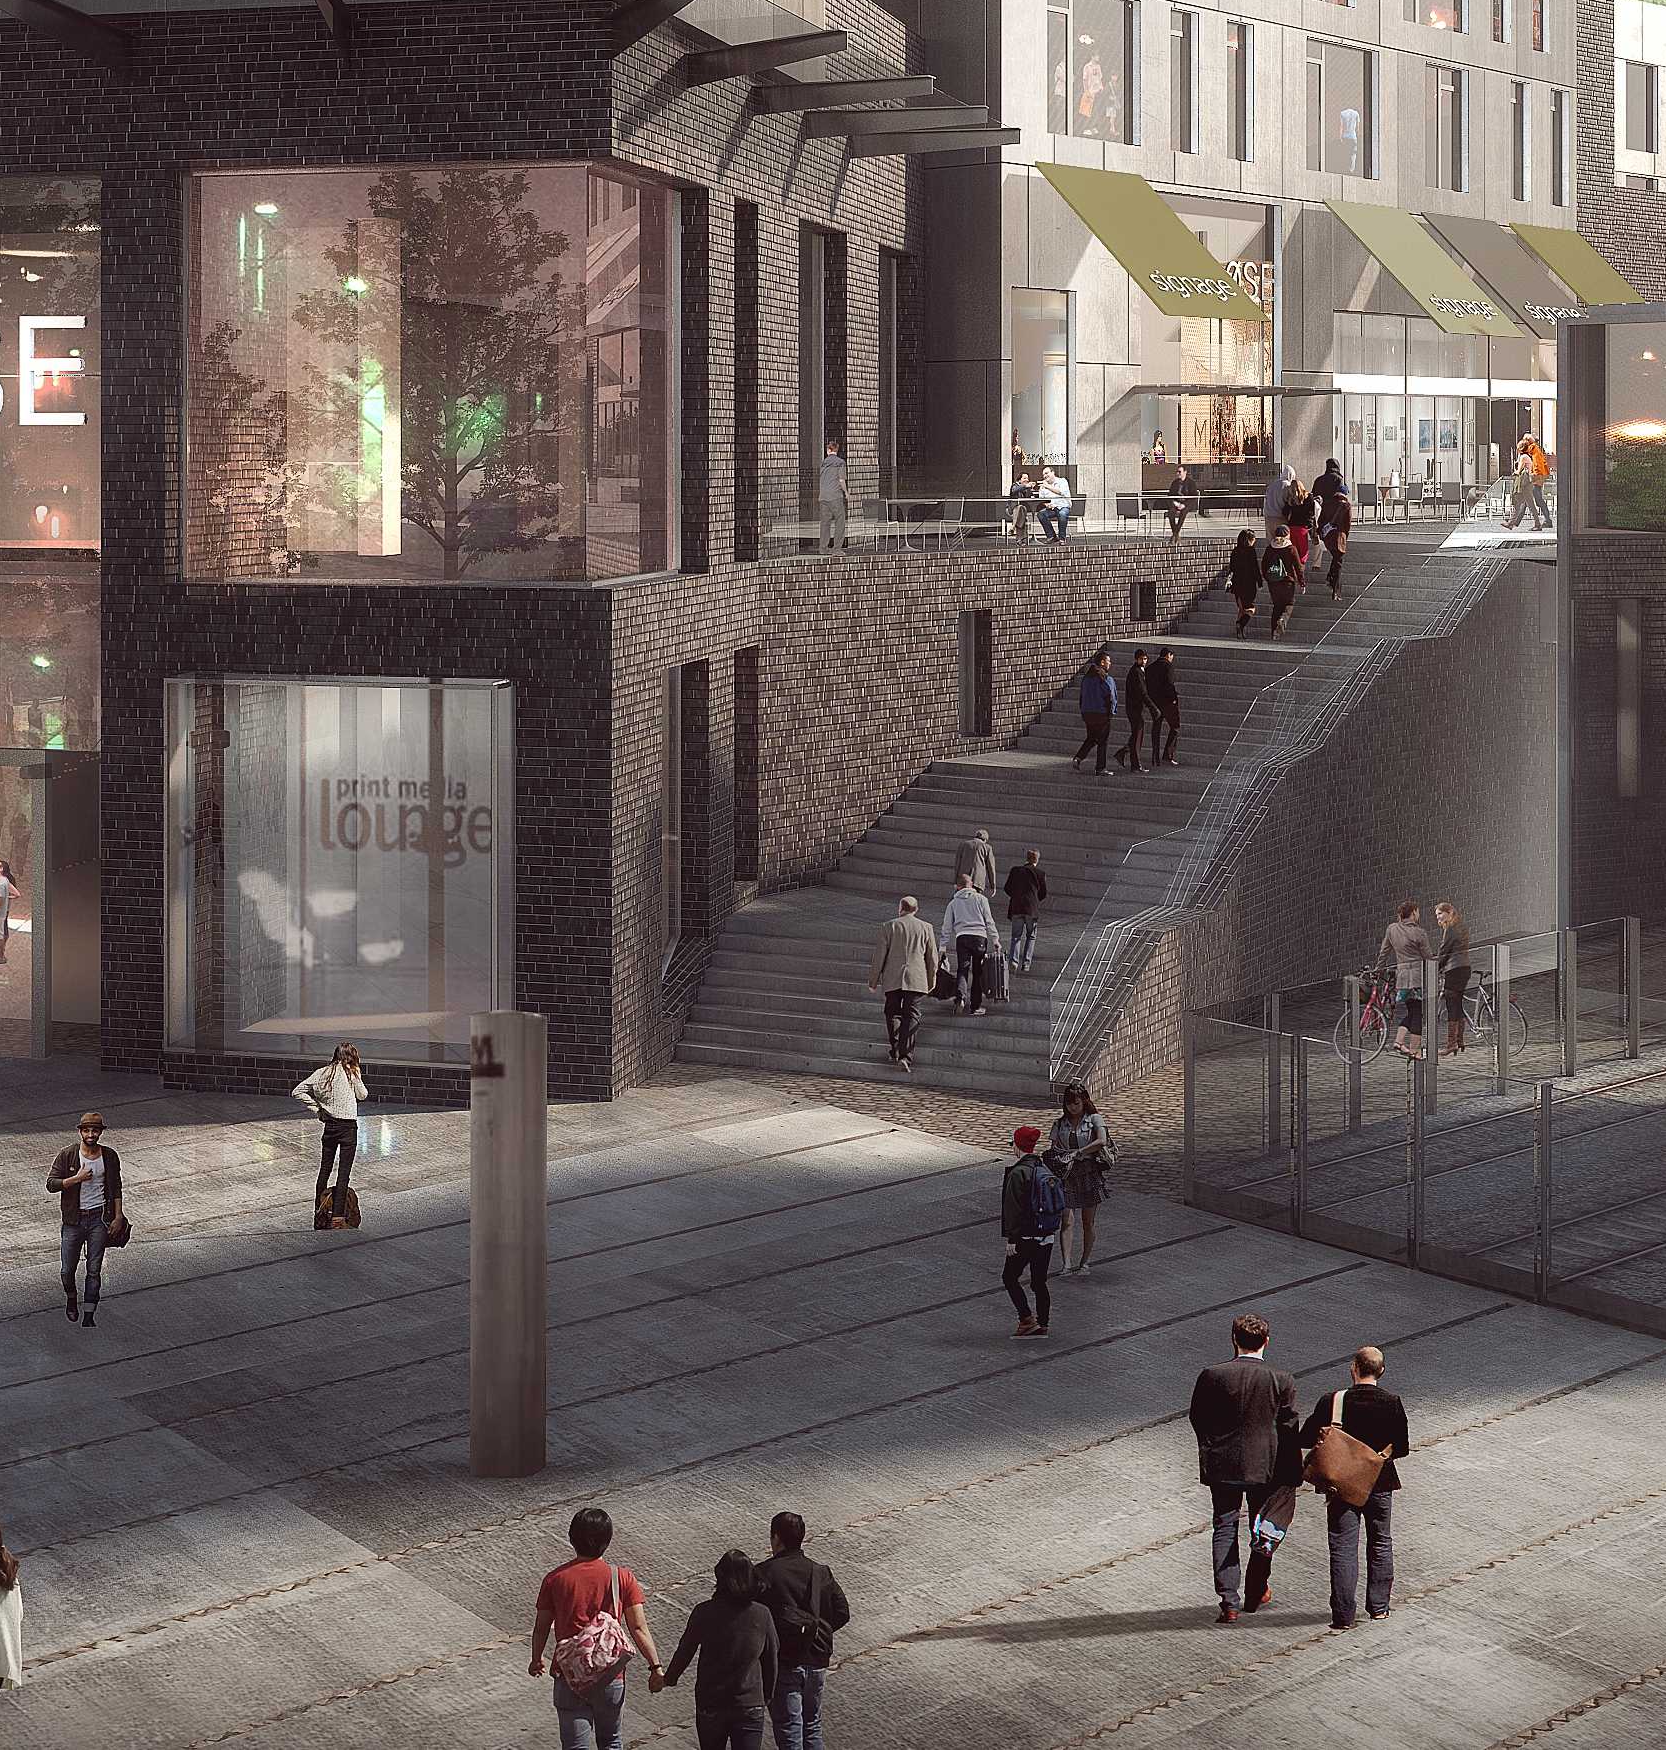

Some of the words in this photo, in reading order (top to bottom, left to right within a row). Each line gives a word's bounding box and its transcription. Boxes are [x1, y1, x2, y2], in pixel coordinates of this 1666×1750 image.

[1149, 269, 1238, 302] signage
[1429, 293, 1499, 321] signage
[336, 775, 391, 801] print
[399, 775, 466, 800] meia
[320, 778, 492, 869] lounge
